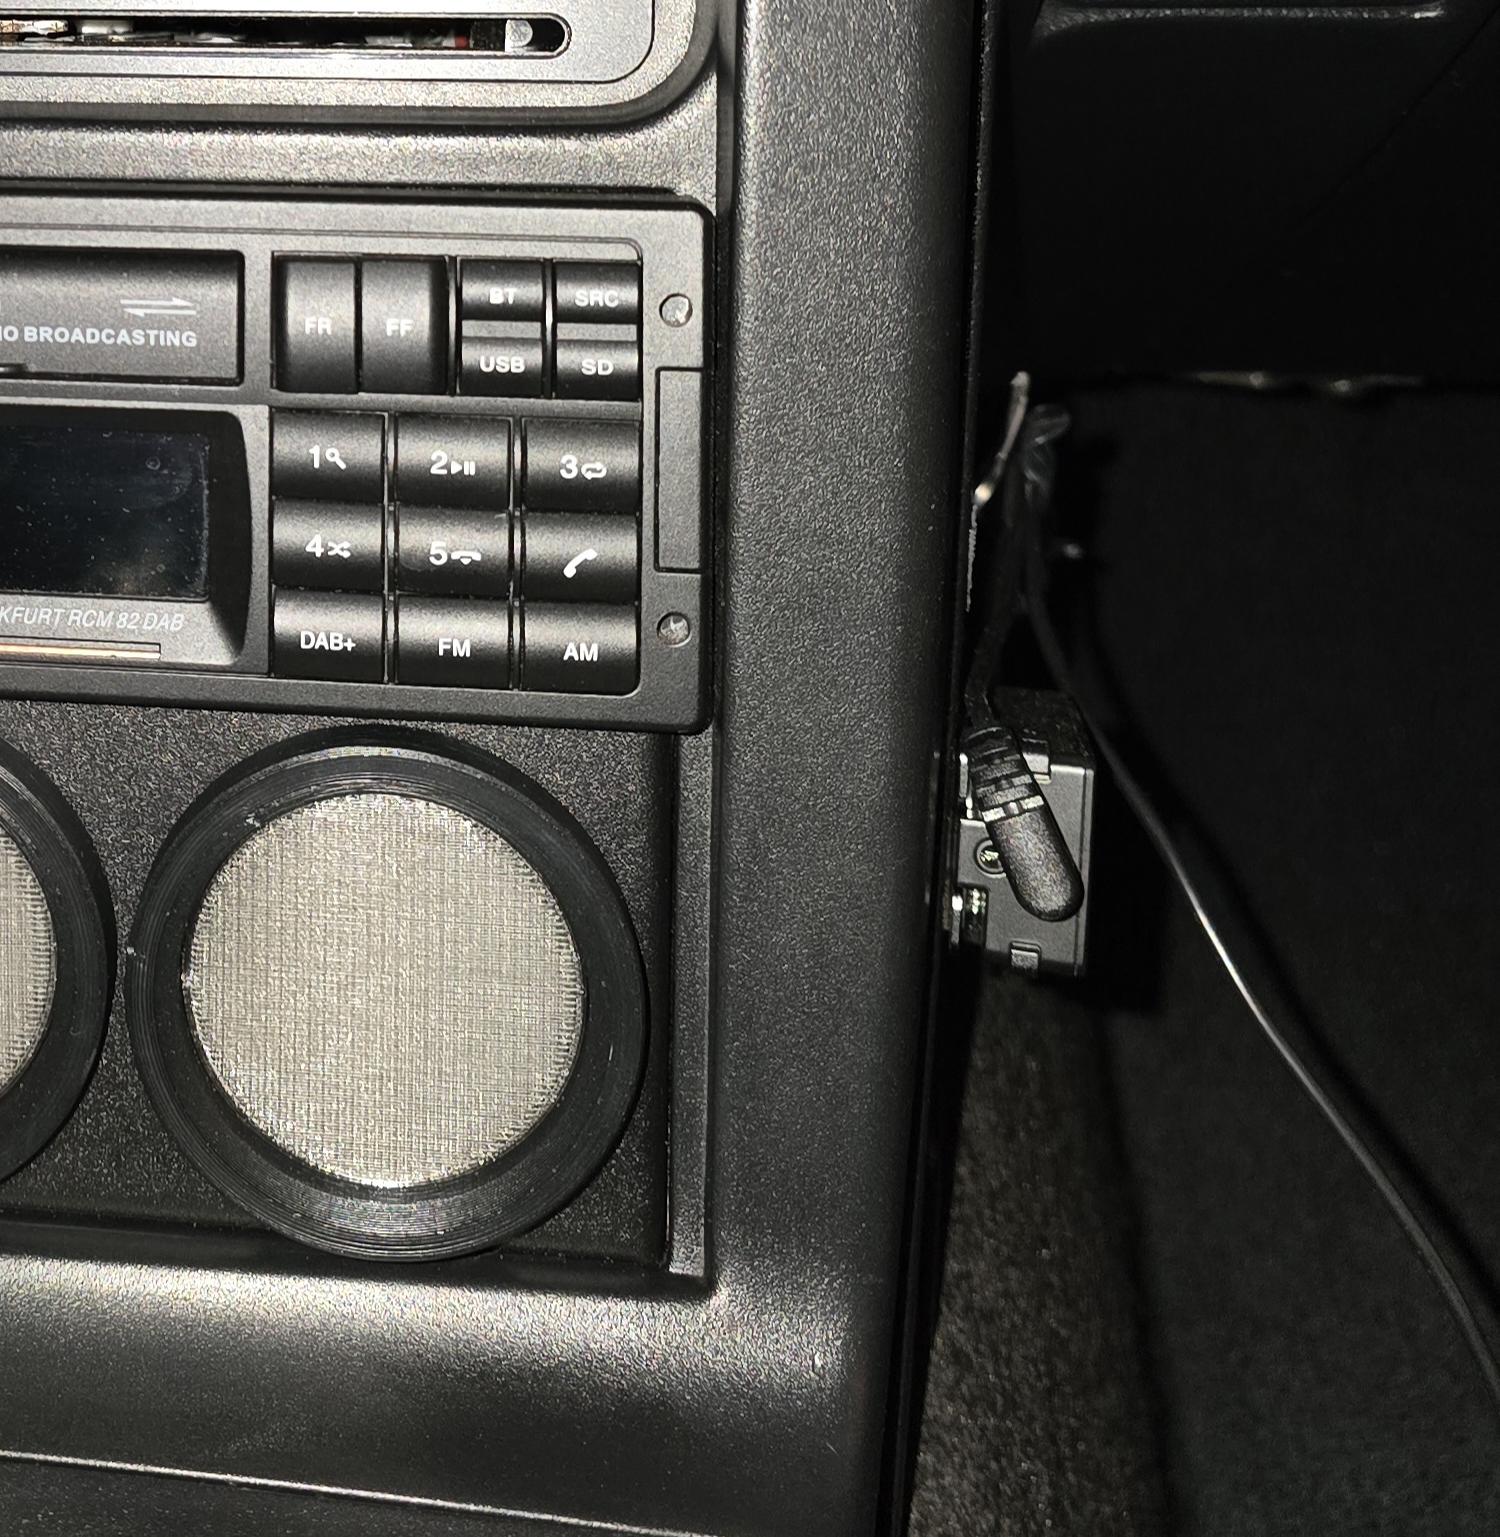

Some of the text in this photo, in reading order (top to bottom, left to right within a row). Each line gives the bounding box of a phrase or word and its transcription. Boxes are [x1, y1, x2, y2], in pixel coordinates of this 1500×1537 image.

[489, 288, 516, 304] BT
[574, 290, 619, 308] SRC
[23, 326, 197, 347] BROADCASTING
[304, 318, 331, 335] FR
[386, 319, 412, 337] FF
[479, 355, 525, 374] USB
[581, 359, 614, 376] SD
[309, 446, 319, 468] 1
[430, 451, 448, 474] 2
[560, 455, 578, 480] 3
[305, 536, 323, 558] 4
[429, 542, 447, 565] 5
[70, 608, 111, 627] RCM
[116, 610, 139, 629] 82
[142, 611, 183, 631] DAB
[300, 631, 356, 652] DAB+
[438, 639, 470, 656] FM
[563, 643, 598, 660] AM
